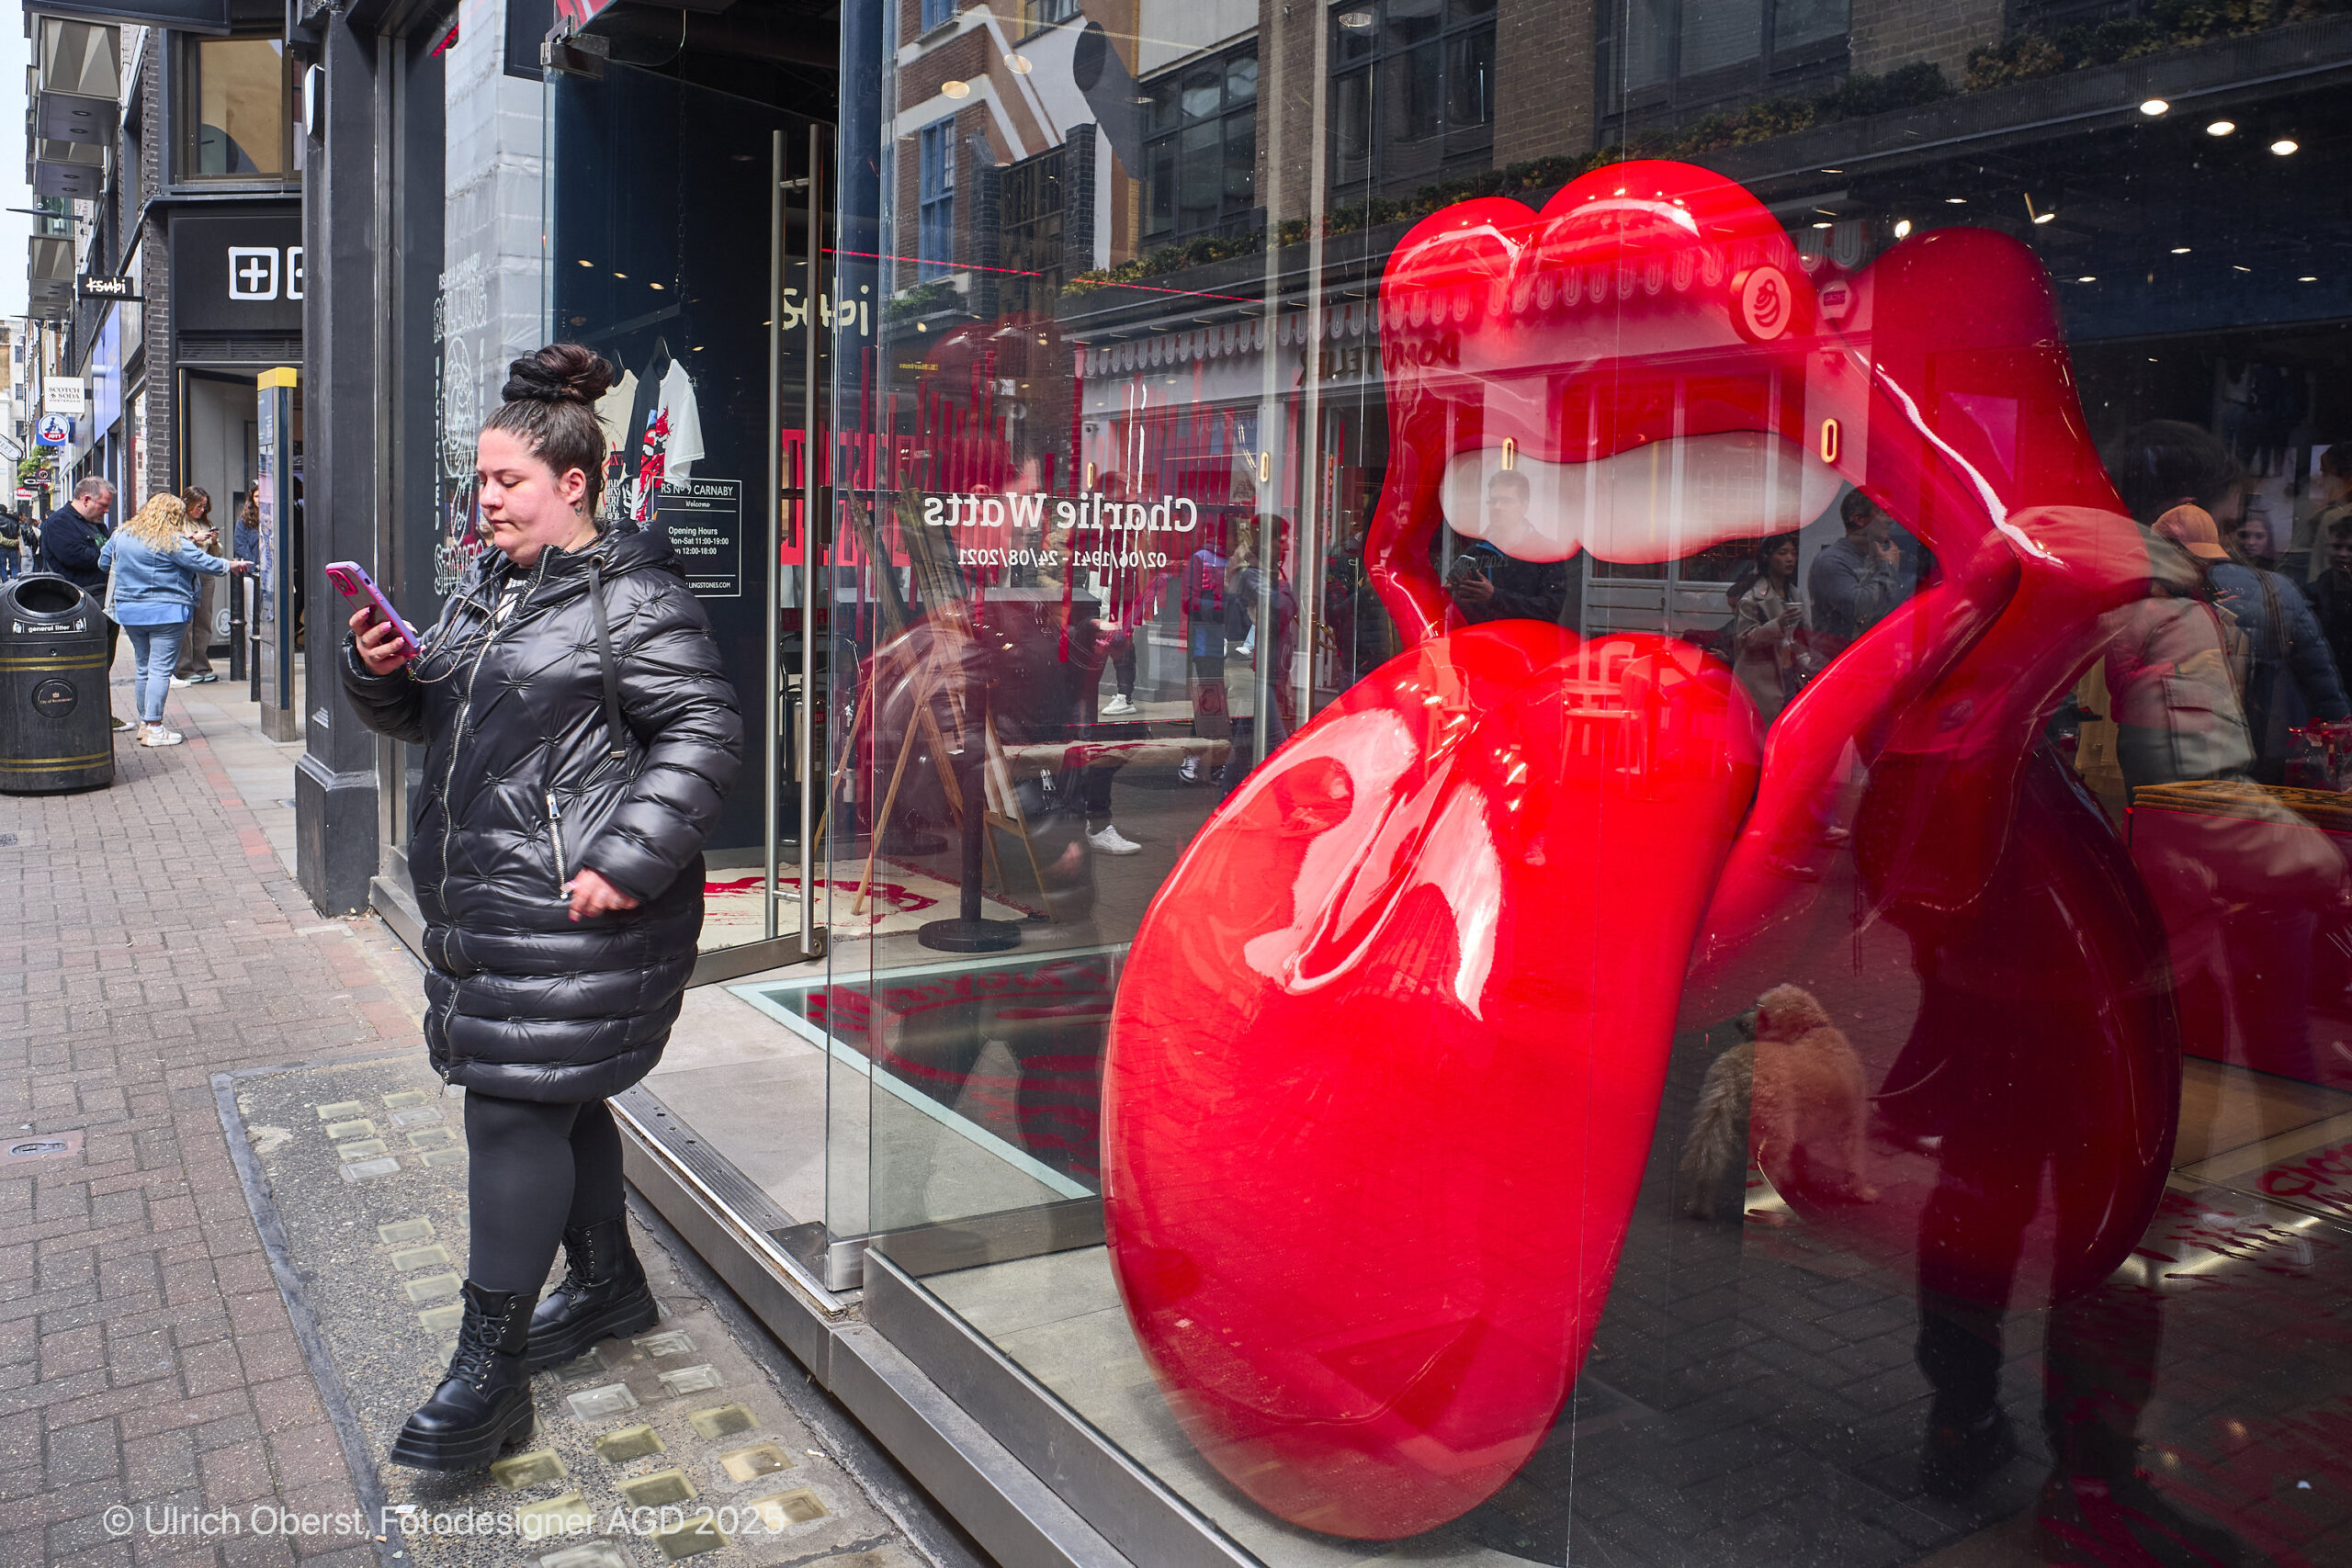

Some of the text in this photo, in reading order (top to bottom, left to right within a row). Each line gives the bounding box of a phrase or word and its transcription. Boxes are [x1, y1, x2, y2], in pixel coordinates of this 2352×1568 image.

[434, 275, 487, 344] ROLLING
[662, 484, 671, 493] RS
[694, 485, 733, 496] CARNABY
[668, 526, 718, 536] Opening Hours
